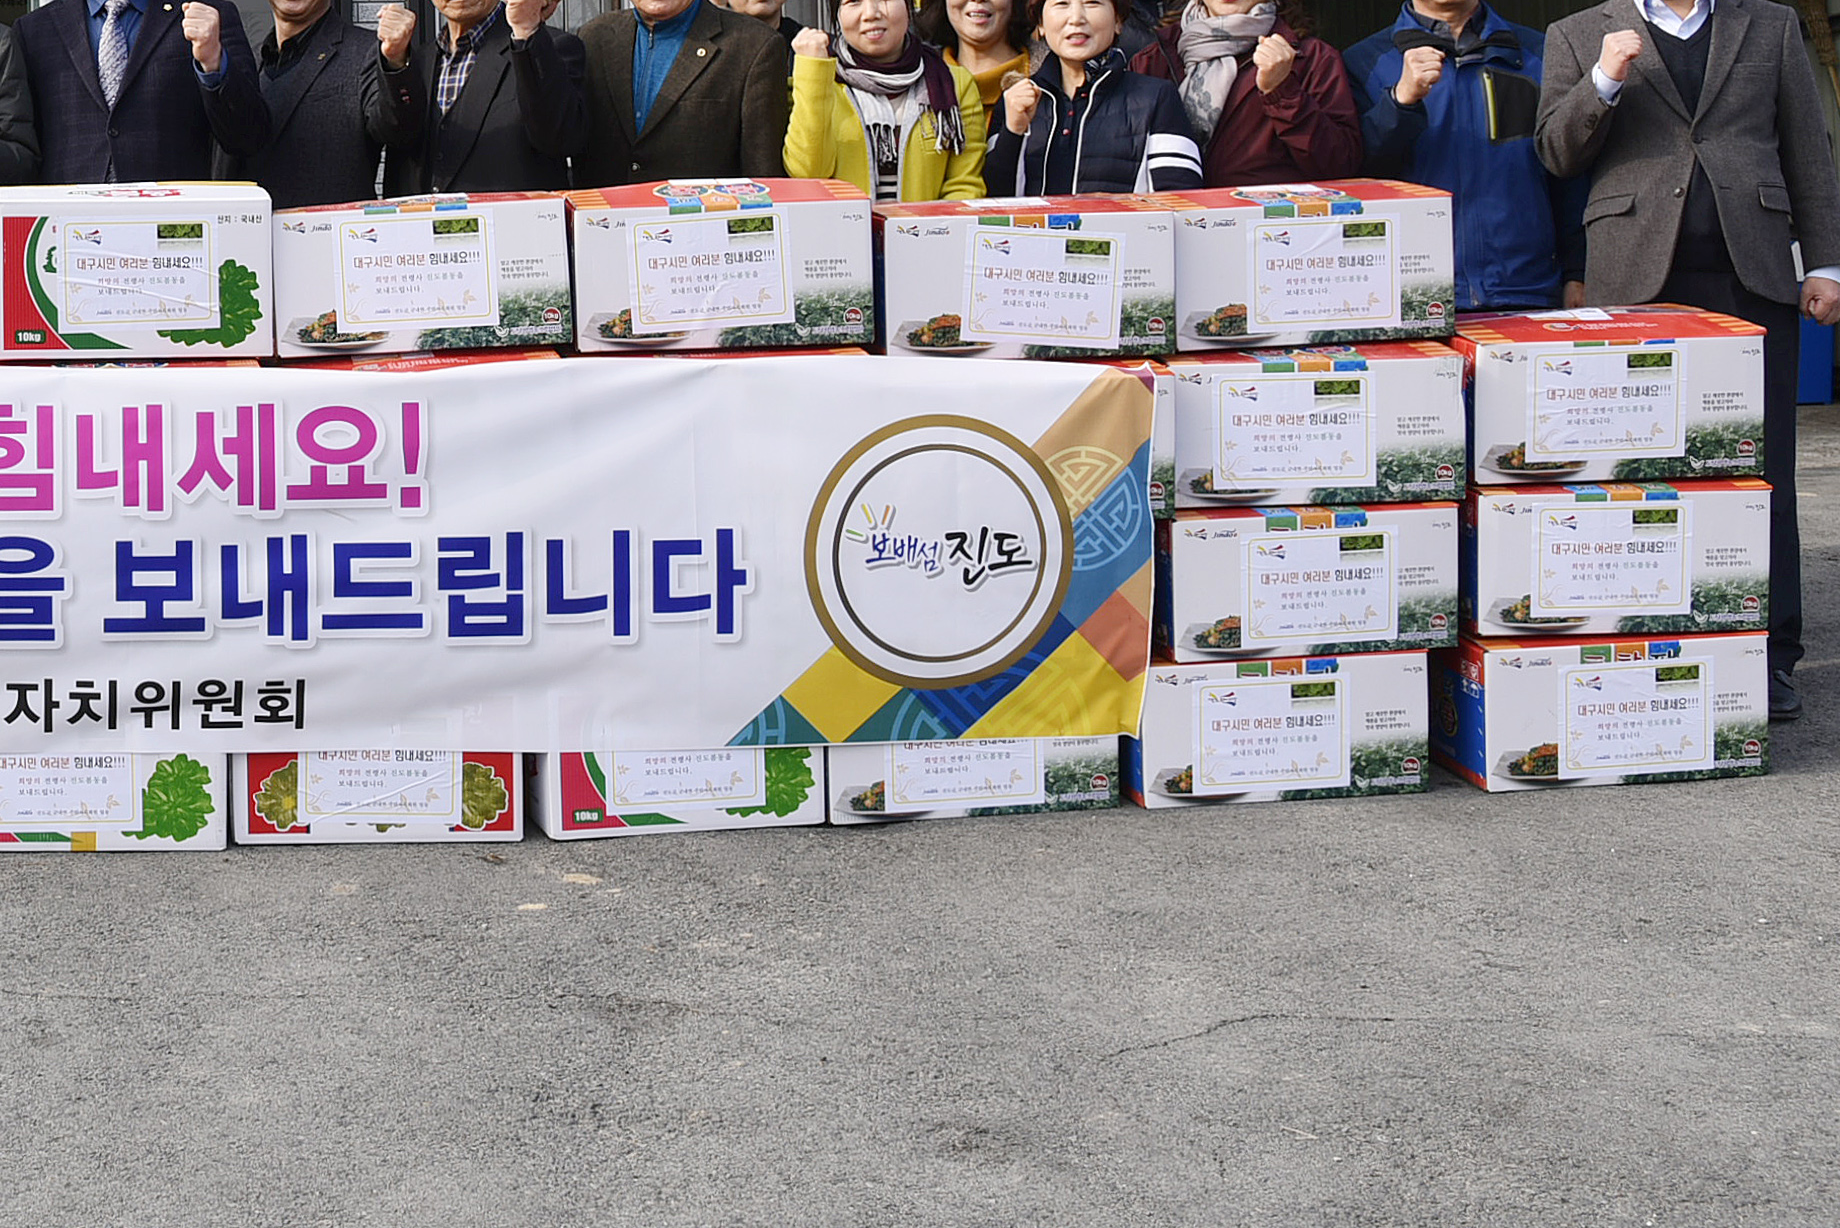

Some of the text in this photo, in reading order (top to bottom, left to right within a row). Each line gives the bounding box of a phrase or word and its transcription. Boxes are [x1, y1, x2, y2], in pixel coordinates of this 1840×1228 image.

[241, 214, 262, 224] 국내산
[76, 256, 203, 270] 대구시민 여러분 힘내세요!!!
[353, 250, 480, 269] 대구시민 여러분 힘내세요!!!
[648, 249, 775, 270] 대구시민 여러분 힘내세요!!!
[1266, 254, 1385, 271] 대구시민 여러분 힘내세요!!!
[17, 331, 42, 342] 10kg
[1546, 384, 1671, 401] 대구시민 여러분 힘내세요!!!
[1232, 412, 1360, 427] 대구시민 여러분 힘내세요!!!
[865, 526, 1032, 585] 보배섬 진도
[1551, 541, 1677, 555] 대구시민 여러분 힘내세요!!!
[103, 528, 747, 641] 보내드립니다
[1577, 697, 1699, 716] 대구시민 여러분 힘내세요!!!
[1212, 714, 1335, 731] 대구시민 여러분 힘내세요!!!
[40, 757, 70, 769] 여러분
[73, 755, 125, 770] 힘내세요!!!
[573, 811, 599, 822] 10kg
